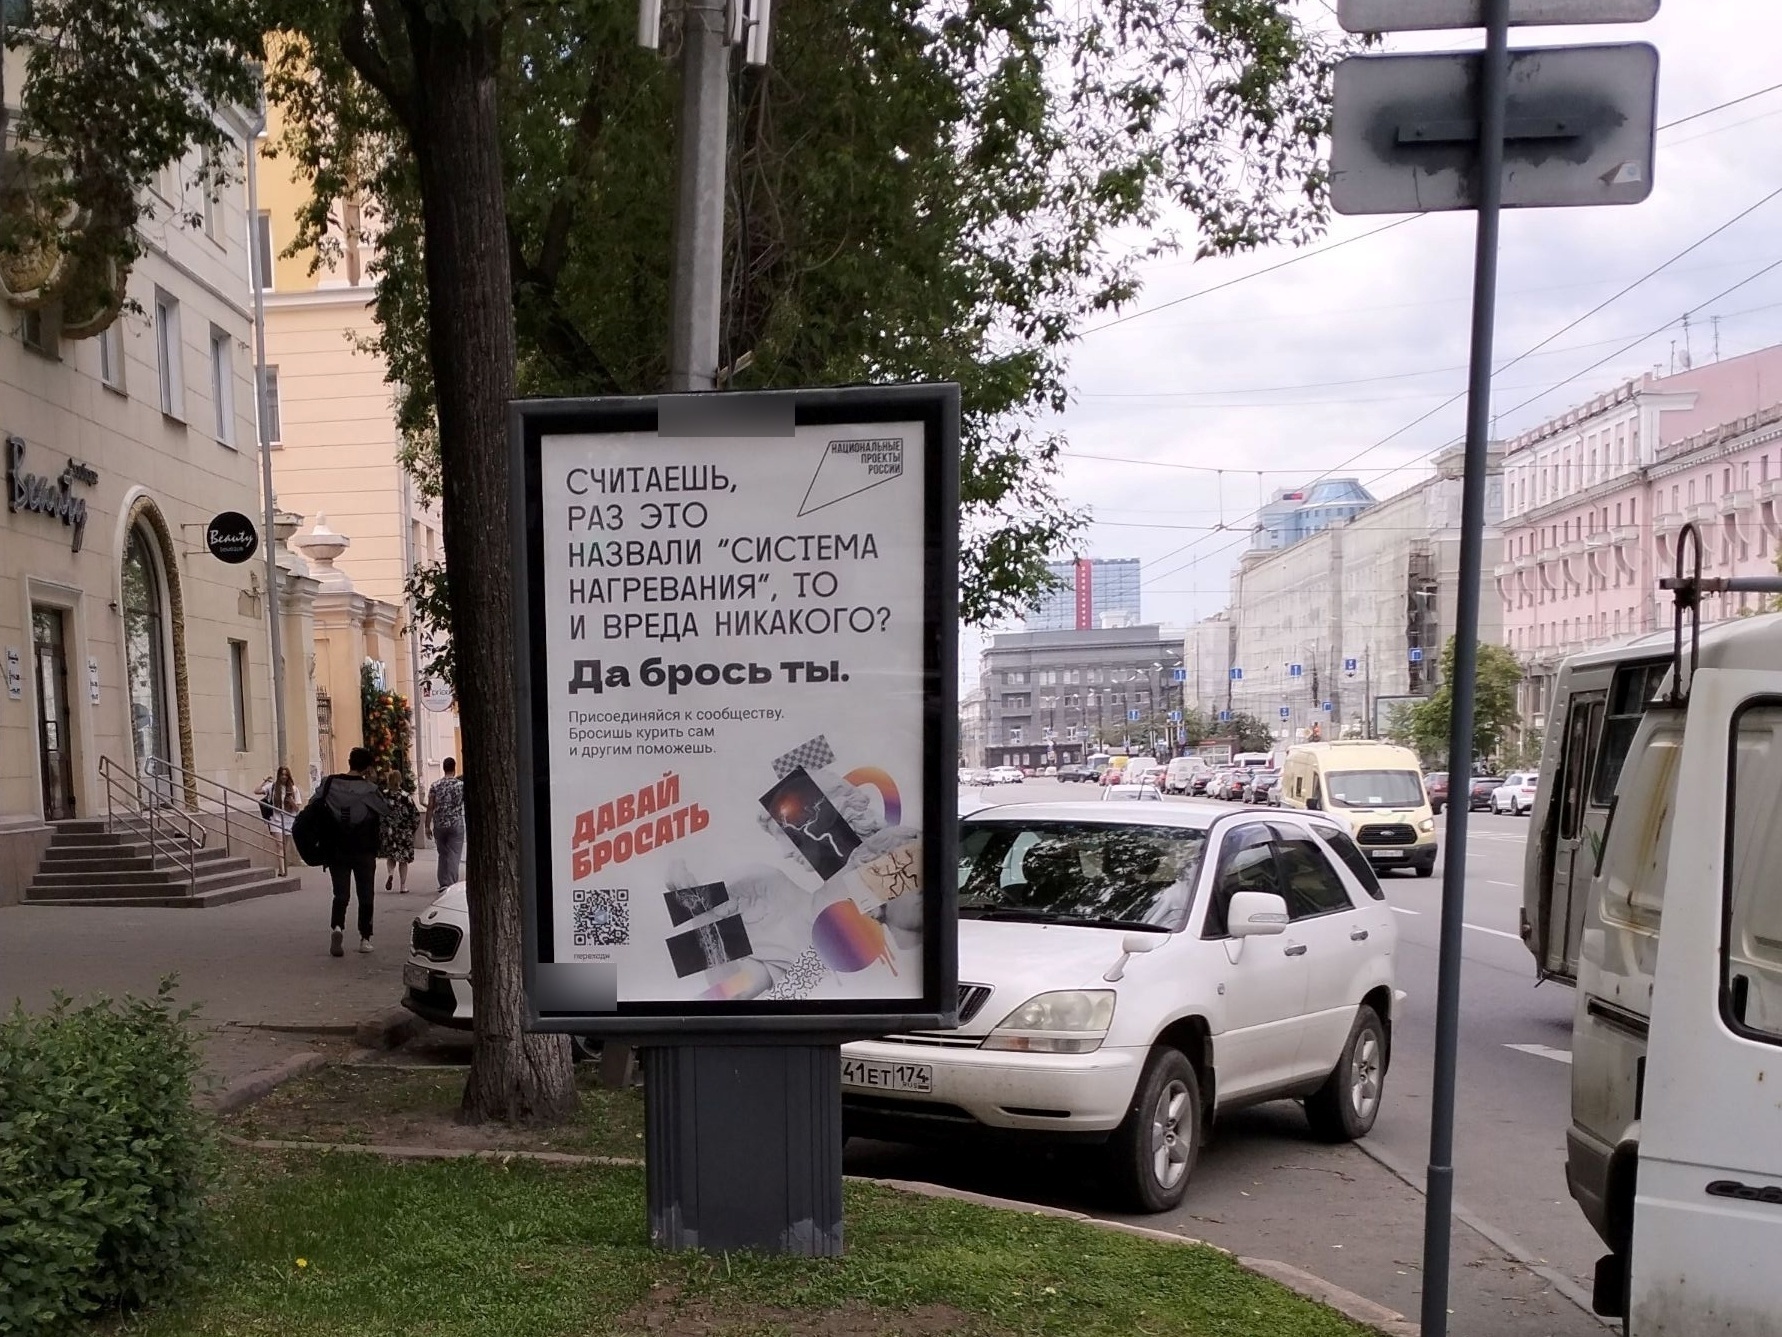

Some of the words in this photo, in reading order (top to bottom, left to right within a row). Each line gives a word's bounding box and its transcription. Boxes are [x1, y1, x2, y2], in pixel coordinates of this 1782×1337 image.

[831, 441, 900, 454] НАЦИОНАЛЬНЫЕ
[861, 452, 900, 464] ПРОЕКТЫ
[566, 465, 737, 495] СЧИТАЕШЬ,
[868, 464, 900, 475] РОССИИ
[568, 504, 624, 531] РАЗ
[640, 501, 708, 529] ЭТО
[209, 529, 254, 548] Beauty
[568, 539, 701, 567] НАЗВАЛИ
[718, 533, 879, 563] "СИСТЕМА
[793, 571, 838, 598] ТО
[570, 615, 585, 640] И
[603, 612, 699, 642] ВРЕДА
[715, 606, 891, 637] НИКАКОГО?
[568, 659, 631, 694] Да
[639, 657, 772, 694] брось
[780, 660, 850, 683] ты.
[568, 709, 680, 725] Присоединяйся
[685, 710, 693, 721] к
[696, 707, 785, 721] сообществу.
[569, 727, 632, 741] Бросишь
[636, 727, 684, 741] курить
[687, 727, 715, 737] сам
[569, 746, 578, 756] и
[581, 745, 633, 758] другим
[636, 743, 717, 755] поможешь.
[571, 769, 680, 850] ДАВАЙ
[571, 802, 710, 882] БРОСАТЬ
[896, 1066, 930, 1084] 174
